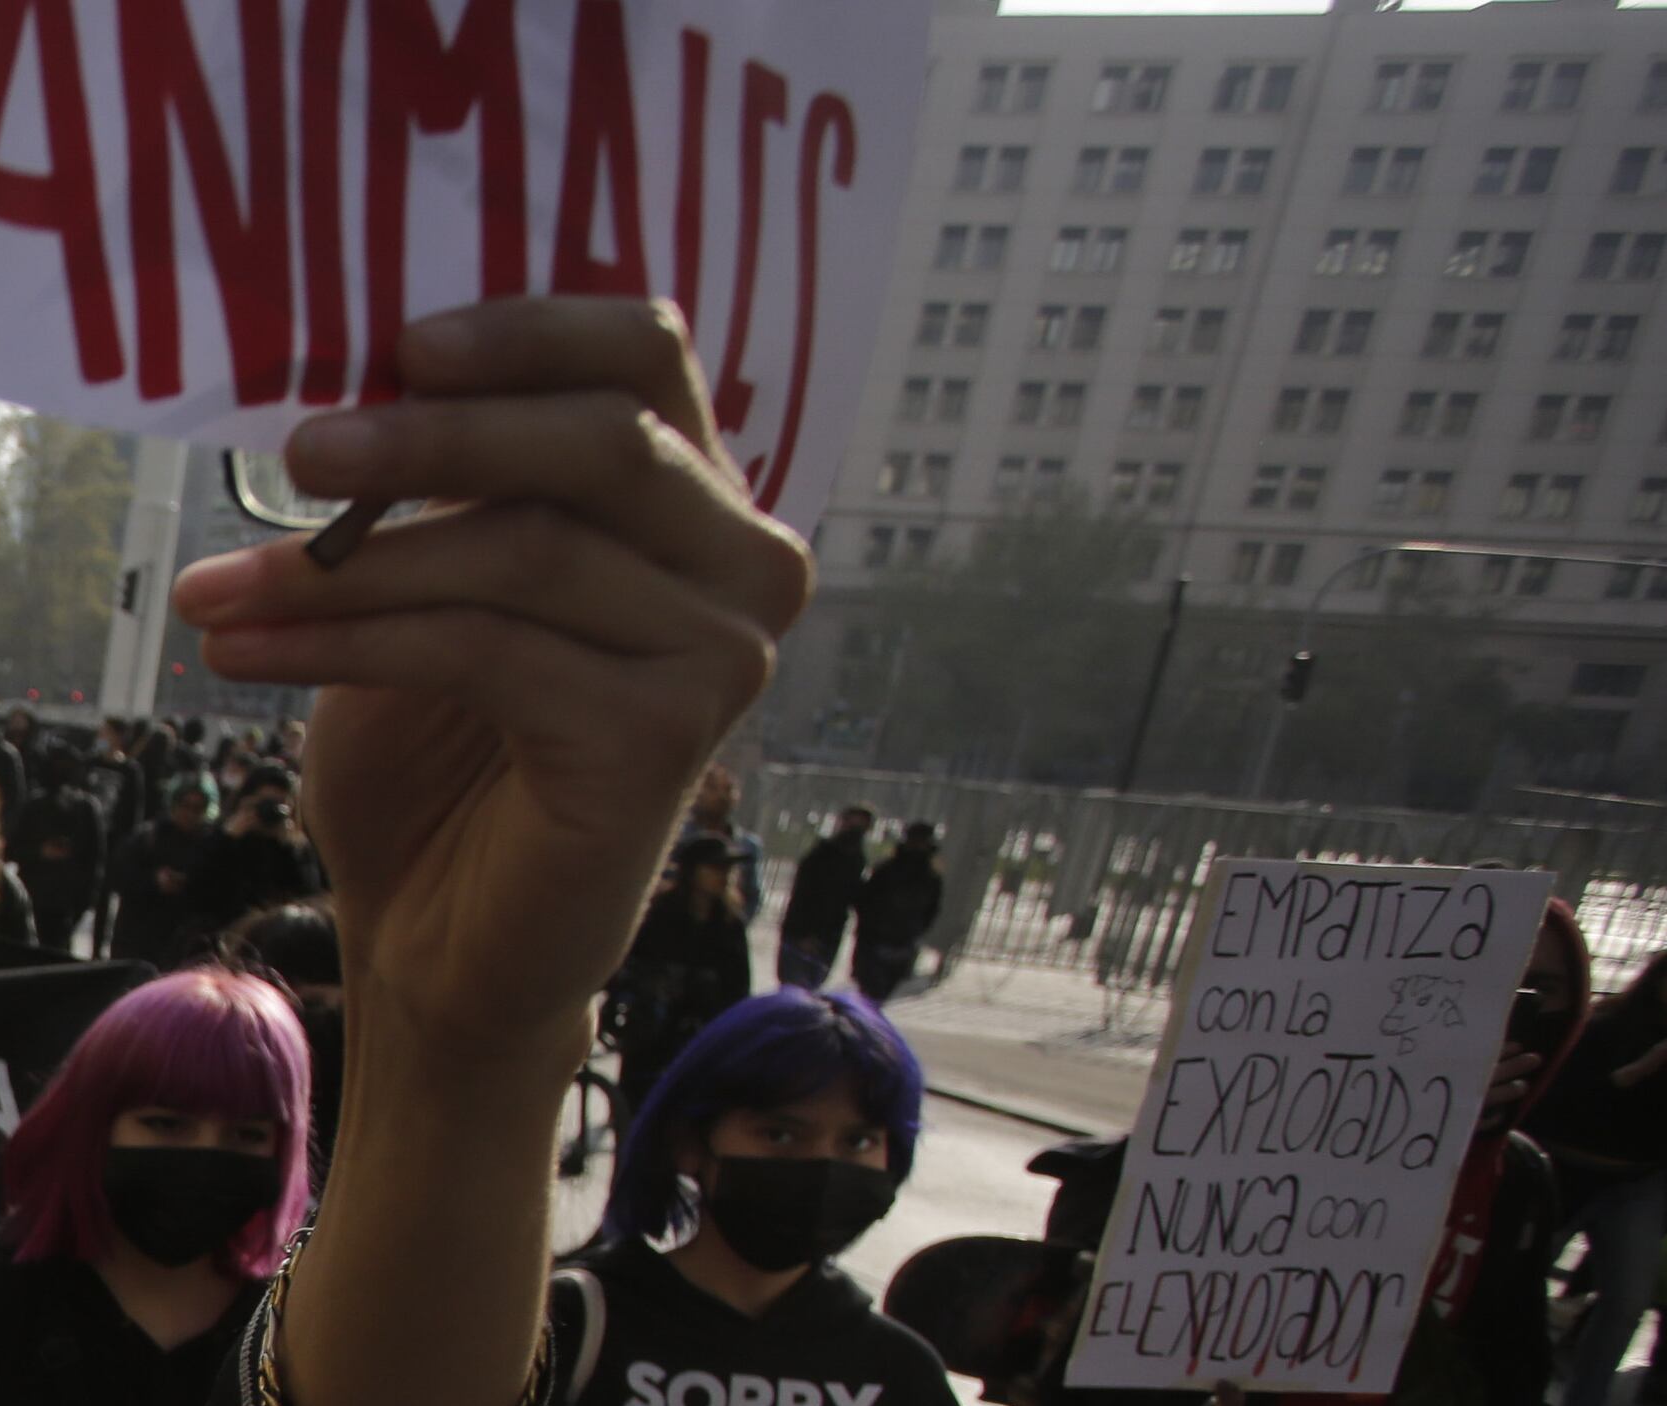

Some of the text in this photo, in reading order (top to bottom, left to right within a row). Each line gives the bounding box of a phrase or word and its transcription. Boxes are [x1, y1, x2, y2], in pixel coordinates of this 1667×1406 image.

[1197, 985, 1275, 1034] con
[1307, 1195, 1388, 1240] con
[1089, 1281, 1135, 1337] EL
